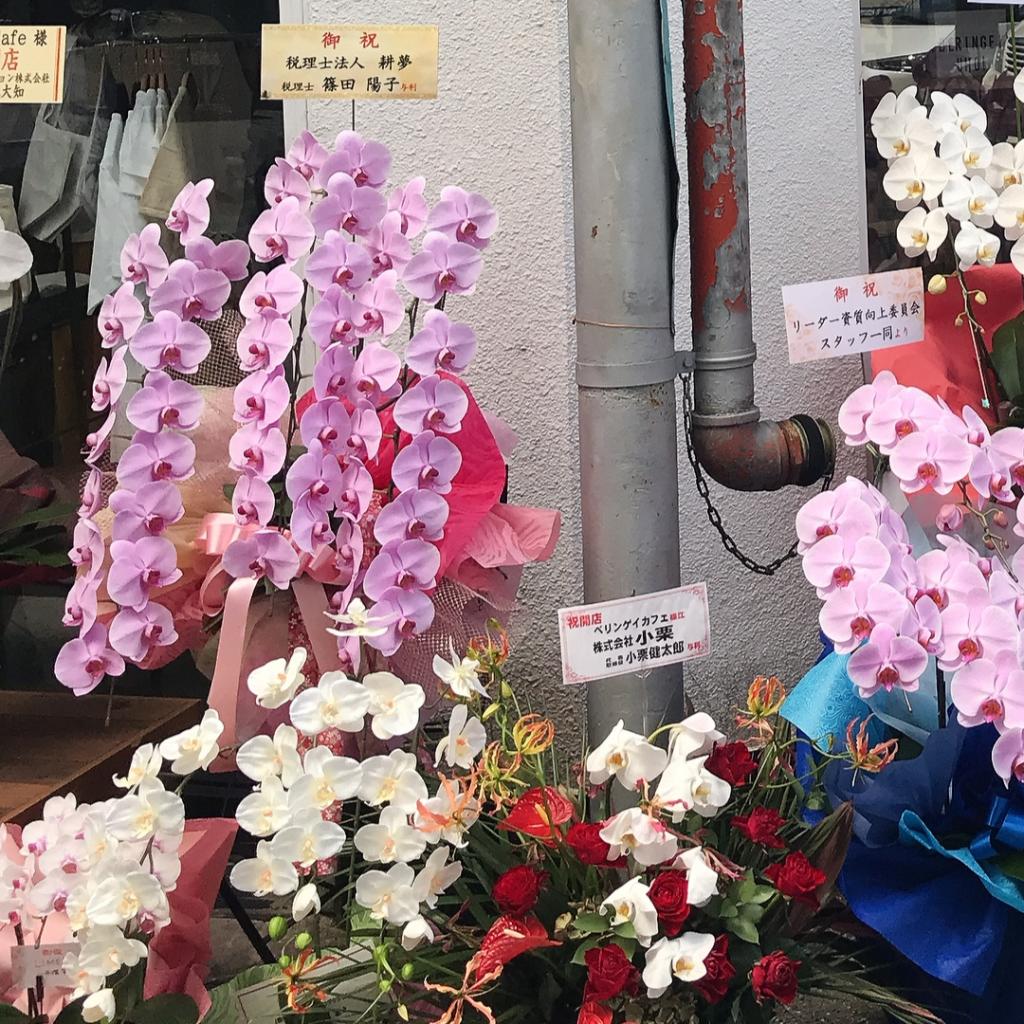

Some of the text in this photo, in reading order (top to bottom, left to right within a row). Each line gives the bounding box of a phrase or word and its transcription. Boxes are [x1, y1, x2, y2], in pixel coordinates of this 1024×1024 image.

[34, 29, 48, 47] 様
[322, 31, 379, 49] 御祝
[1, 48, 19, 71] 店
[286, 55, 365, 70] 税理士法人
[2, 84, 24, 98] 大知
[281, 81, 314, 91] 税理士
[366, 76, 399, 93] 陽子
[834, 281, 878, 303] 御祝
[793, 301, 920, 333] リーダー資質向上委員会
[567, 613, 602, 629] 祝開店
[625, 641, 684, 664] 小栗健太郎
